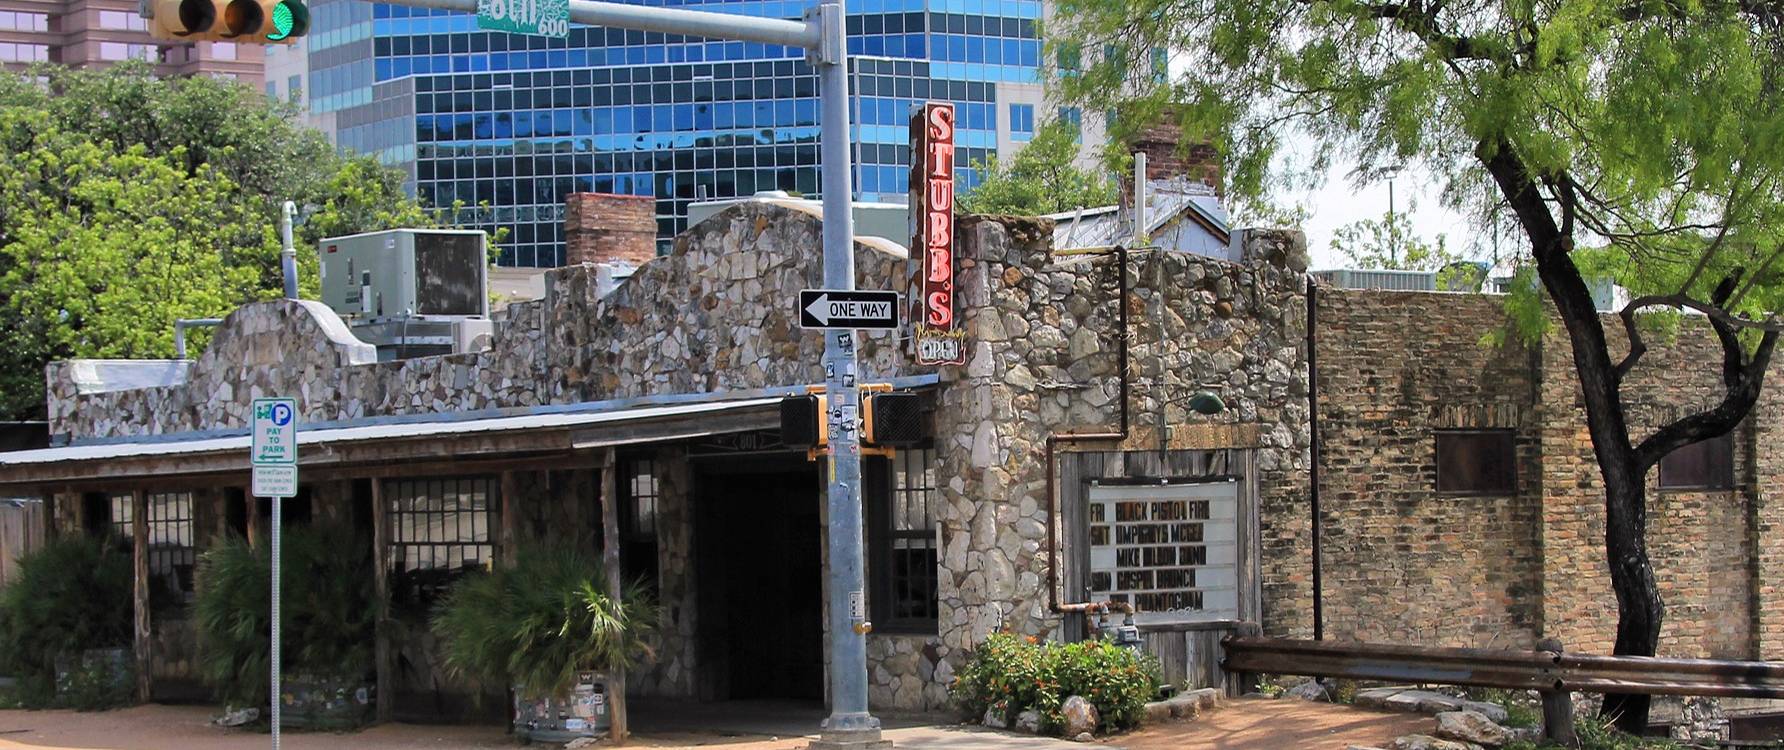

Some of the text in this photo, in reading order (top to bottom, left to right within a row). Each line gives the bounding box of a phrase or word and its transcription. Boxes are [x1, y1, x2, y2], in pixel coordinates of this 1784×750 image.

[539, 18, 568, 37] 600
[929, 106, 953, 326] STUBB'S
[830, 303, 887, 317] ONE WAY
[922, 340, 958, 360] OPEN
[262, 445, 286, 453] PARK
[269, 436, 280, 444] TO
[1090, 503, 1105, 522] FRI
[1115, 502, 1148, 522] BLACK
[1151, 501, 1187, 521] PISTOL
[1116, 547, 1140, 568] MIKE
